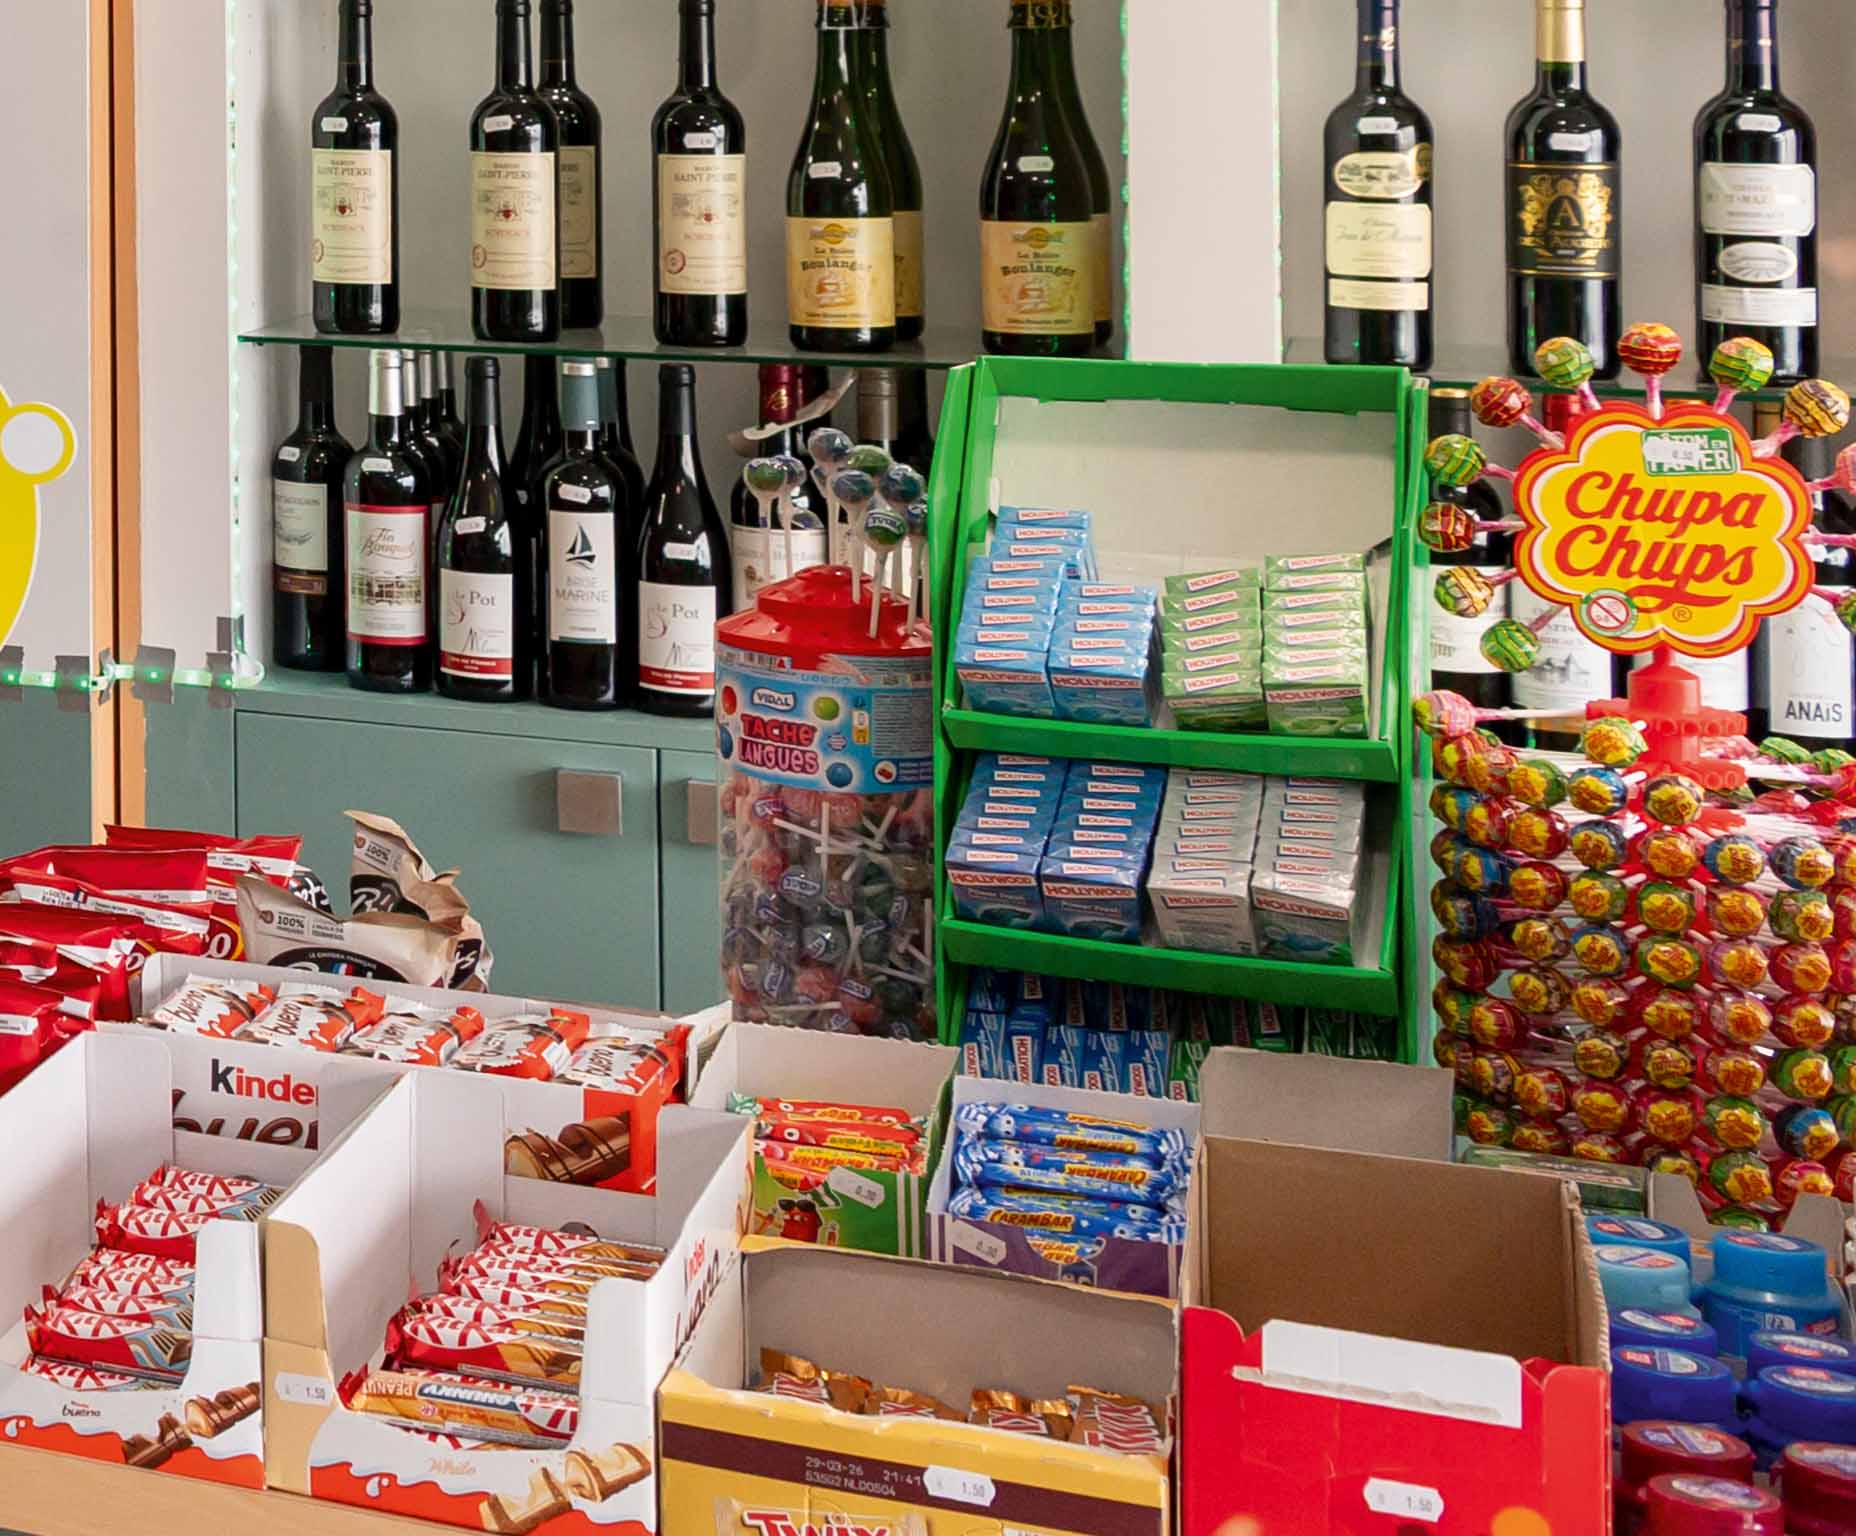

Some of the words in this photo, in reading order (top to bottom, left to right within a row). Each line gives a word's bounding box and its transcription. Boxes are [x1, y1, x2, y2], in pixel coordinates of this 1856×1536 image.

[1564, 470, 1768, 537] Chupa
[1554, 525, 1760, 614] Chups
[468, 590, 496, 607] Pot
[554, 588, 610, 605] MARINE
[671, 602, 699, 619] Pot
[959, 671, 1043, 683] HOLLYWOOD
[1054, 676, 1140, 688] HOLLYWOOD
[757, 691, 791, 706] VIDAL
[1267, 689, 1361, 702] HOLLYWOOD
[951, 872, 1034, 885] HOLLYWOOD
[1045, 886, 1135, 898] HOLLYWOOD
[1177, 896, 1247, 906] HOLLYWOOD
[1266, 897, 1356, 919] HOLLYWOOD
[276, 915, 305, 929] 100%
[210, 1058, 318, 1106] kinde
[168, 1169, 257, 1197] KitKat
[407, 1316, 517, 1350] KitKat
[61, 1401, 102, 1420] bueno
[805, 1454, 865, 1476] 29-03-26
